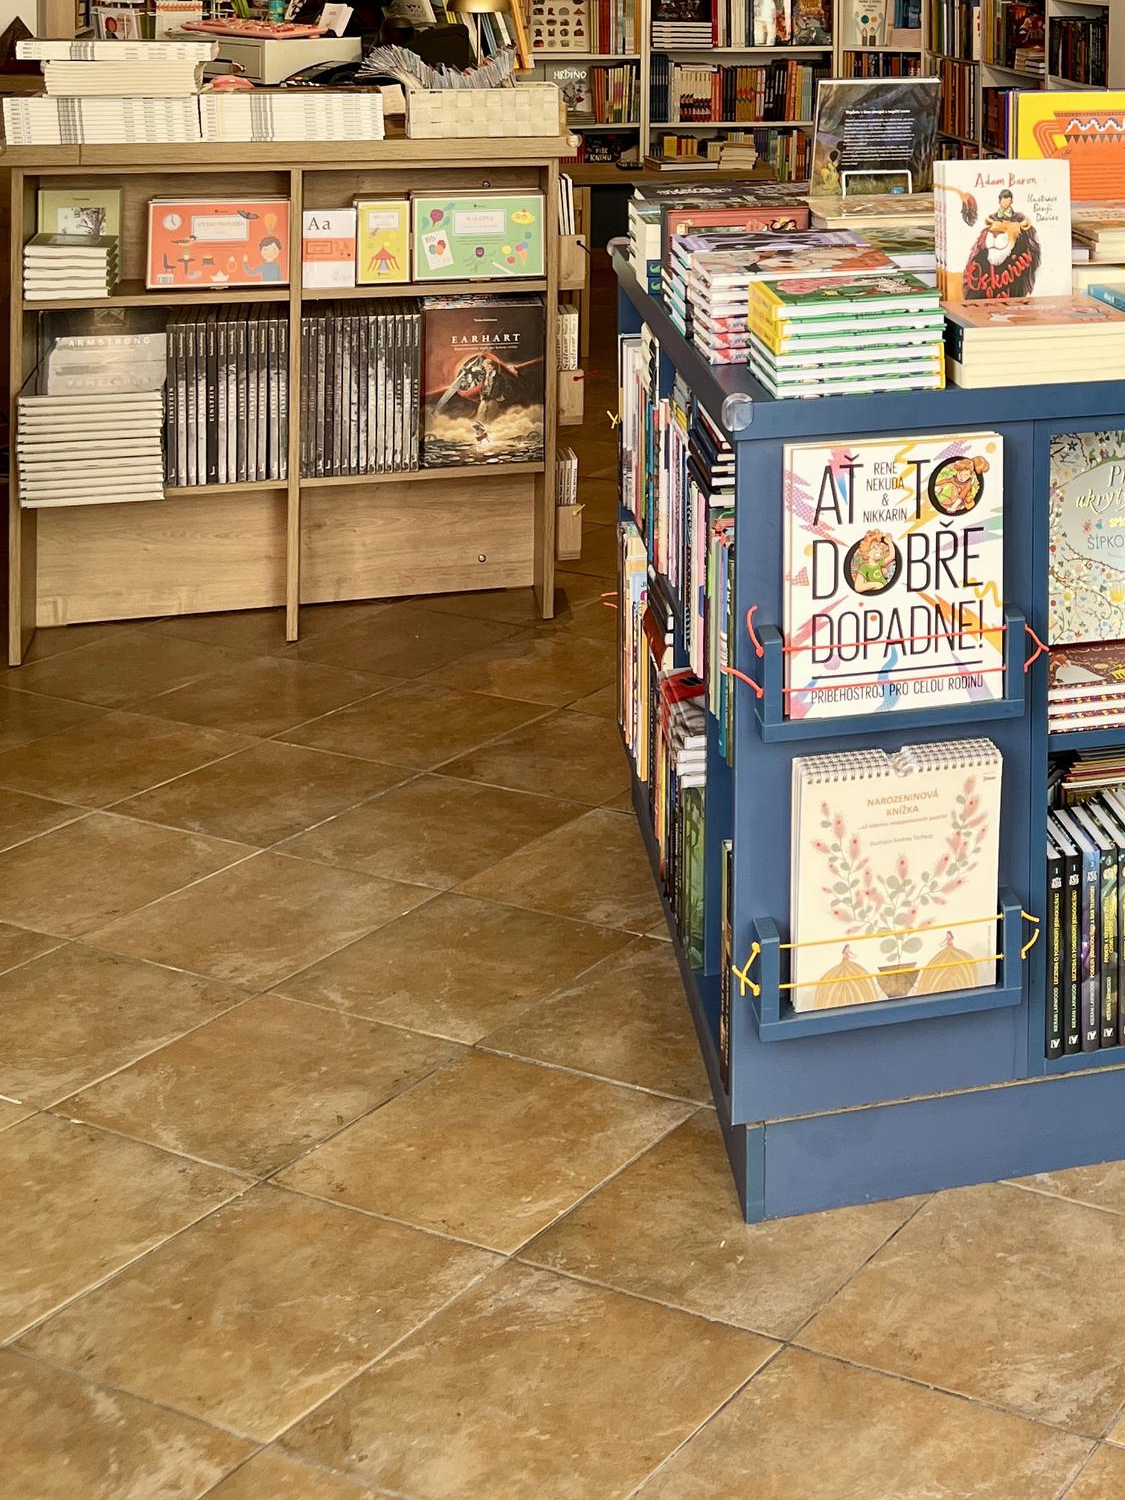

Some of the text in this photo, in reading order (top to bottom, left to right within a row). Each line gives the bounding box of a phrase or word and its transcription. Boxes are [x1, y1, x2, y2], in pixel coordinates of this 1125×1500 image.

[974, 173, 1036, 188] Adam Baron
[451, 333, 521, 344] EARHART
[813, 454, 985, 526] AŤ TO
[866, 476, 904, 491] NEKUDA
[881, 493, 889, 507] &
[862, 508, 908, 524] NIKKARIN
[812, 520, 985, 600] DOBŘE
[811, 600, 984, 665] DOPADNE!
[889, 682, 909, 697] PRO
[913, 679, 944, 694] CELOU
[948, 674, 984, 690] RODINU
[886, 805, 919, 817] KNÍŽKA
